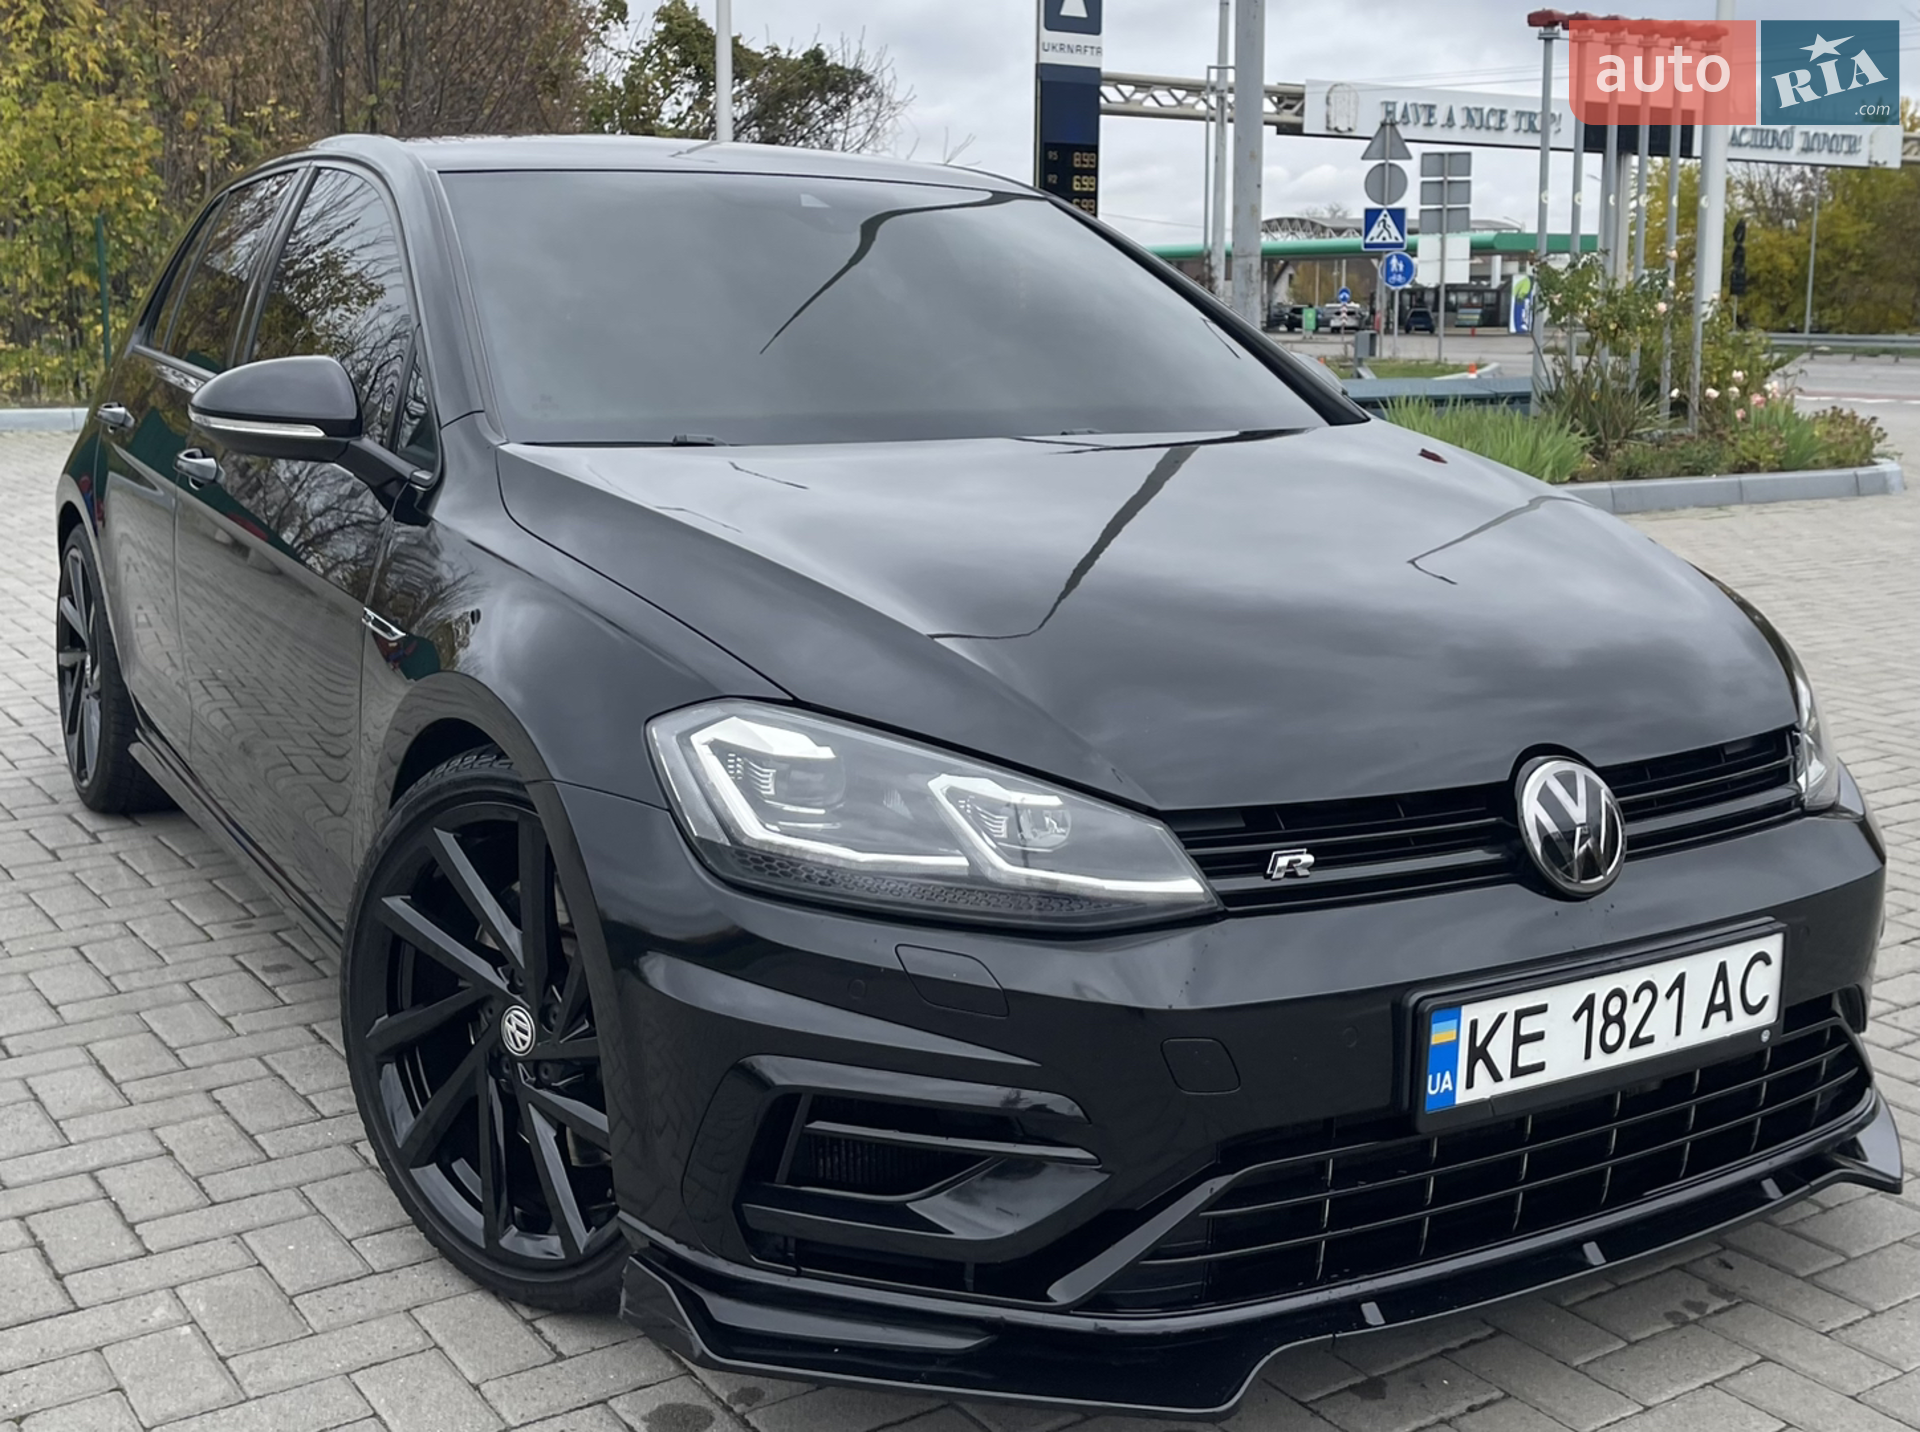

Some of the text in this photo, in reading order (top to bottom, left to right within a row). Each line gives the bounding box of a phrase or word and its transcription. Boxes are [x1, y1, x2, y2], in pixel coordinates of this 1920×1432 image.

[1042, 42, 1103, 56] UKRNAFTA
[1380, 101, 1562, 134] HAVE A NICE TRP!
[1729, 125, 1796, 151] АСЛИВОЇ
[1267, 848, 1315, 879] R
[1465, 950, 1773, 1090] KE 1821 AC
[1427, 1070, 1454, 1095] UA
